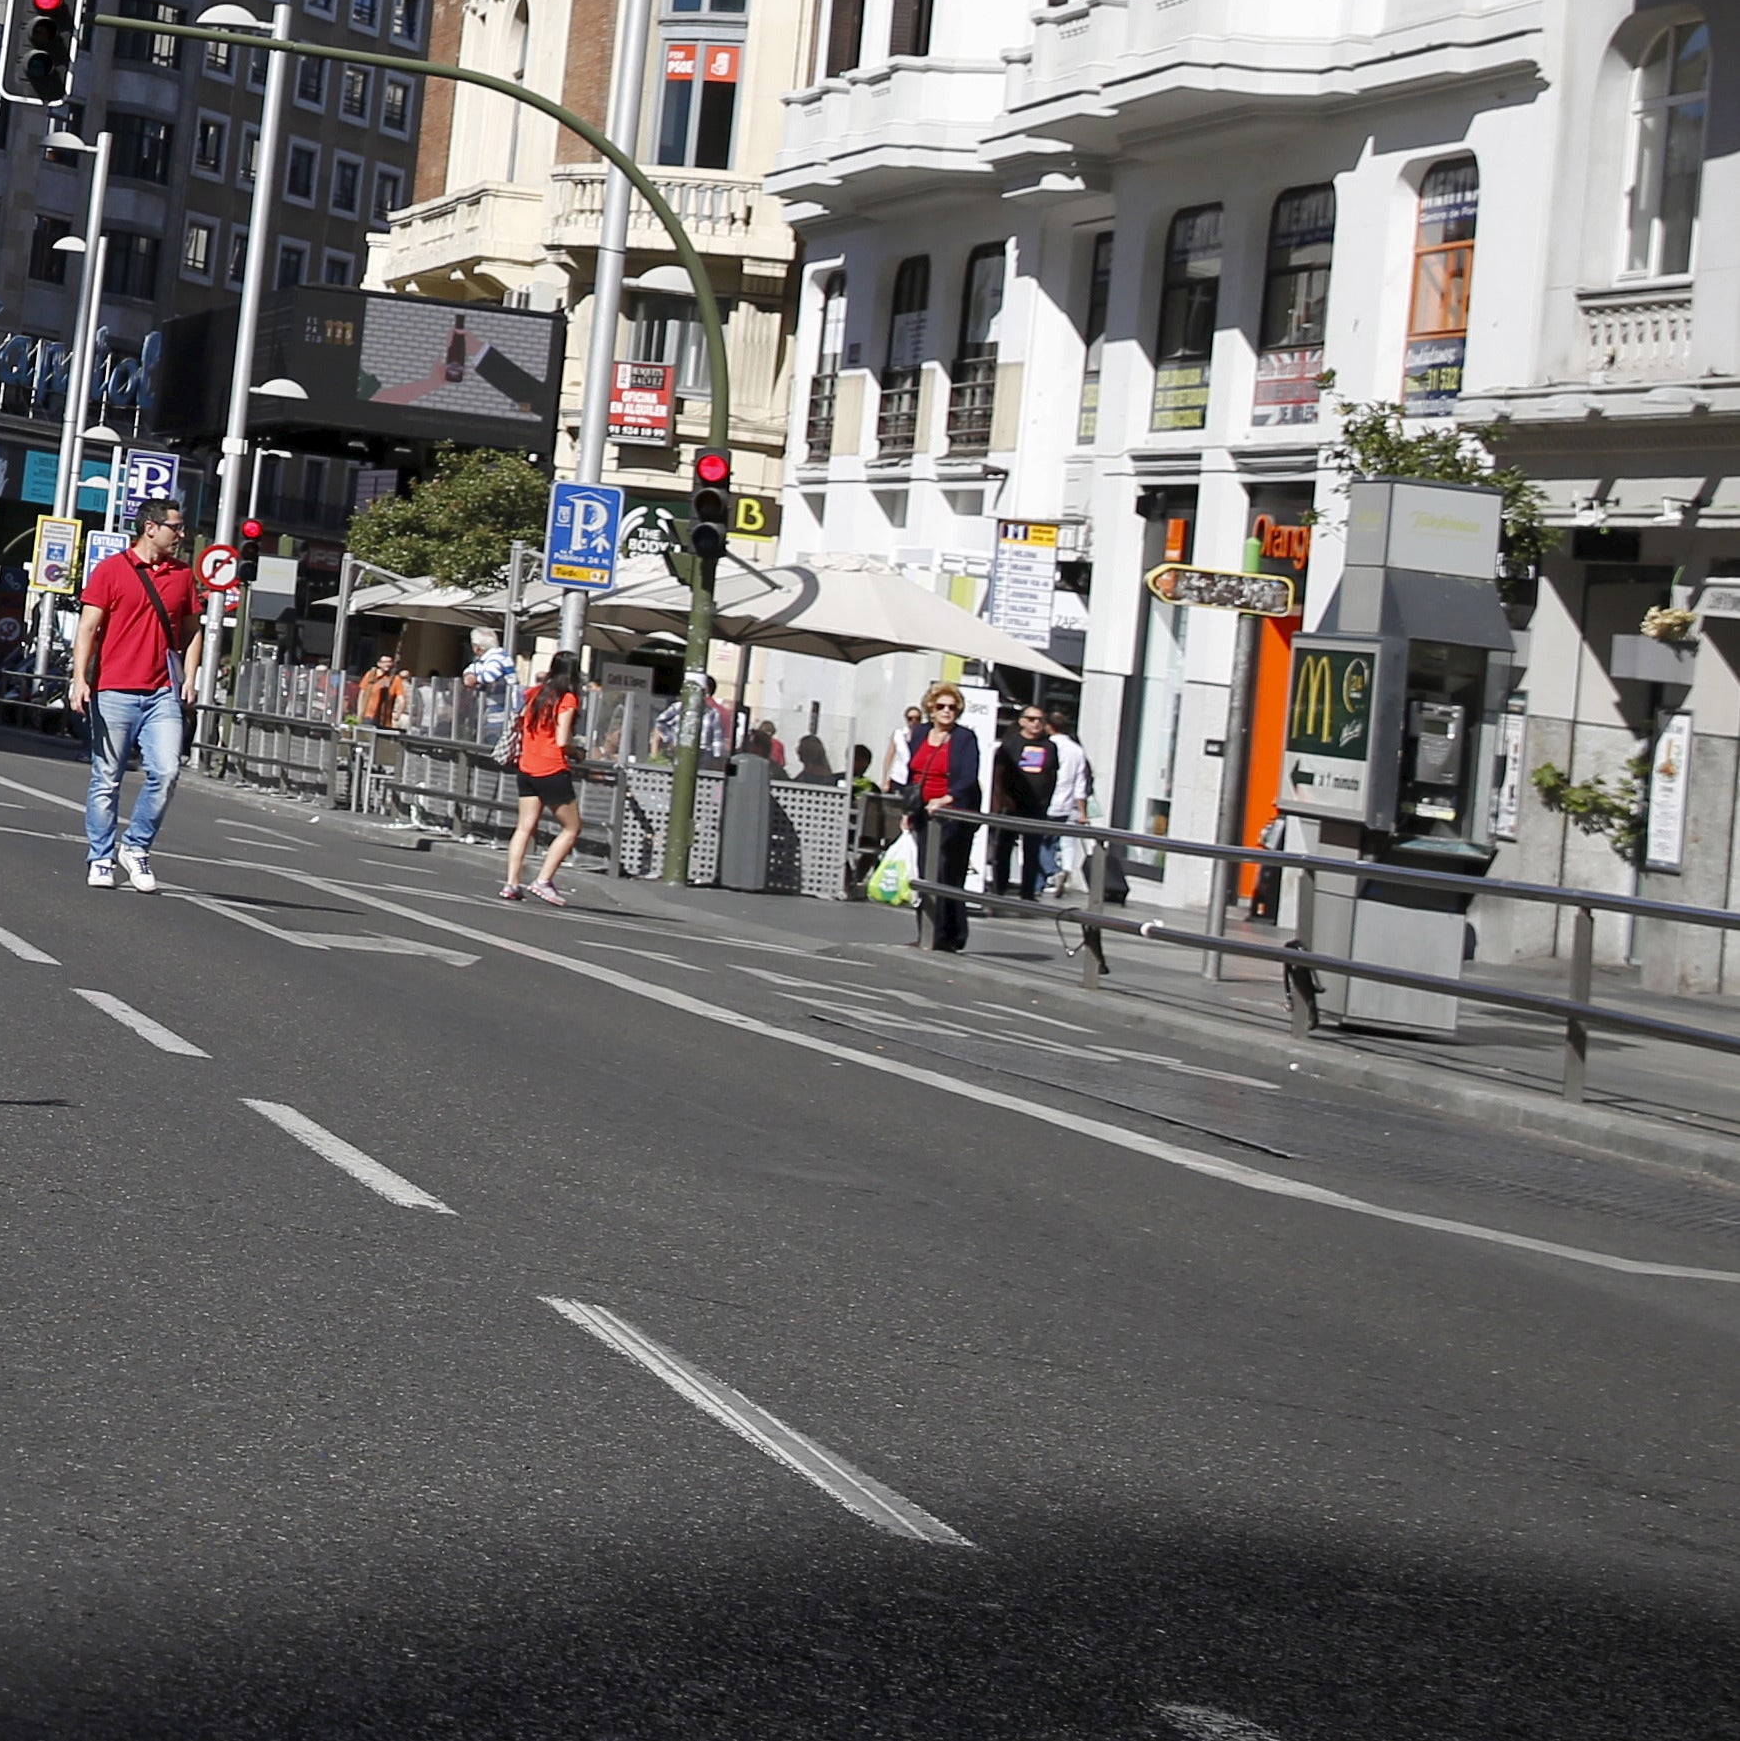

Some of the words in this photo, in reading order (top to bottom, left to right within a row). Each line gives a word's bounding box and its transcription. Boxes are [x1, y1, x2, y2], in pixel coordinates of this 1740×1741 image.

[621, 391, 658, 404] OFICINA
[610, 401, 623, 414] EN
[624, 403, 668, 417] ALQUILER
[129, 461, 171, 499] P
[736, 497, 765, 531] B
[571, 498, 609, 551] P
[637, 527, 662, 539] THE
[92, 535, 124, 547] ENTRADA
[628, 538, 670, 552] BODY
[1333, 776, 1360, 791] minuto
